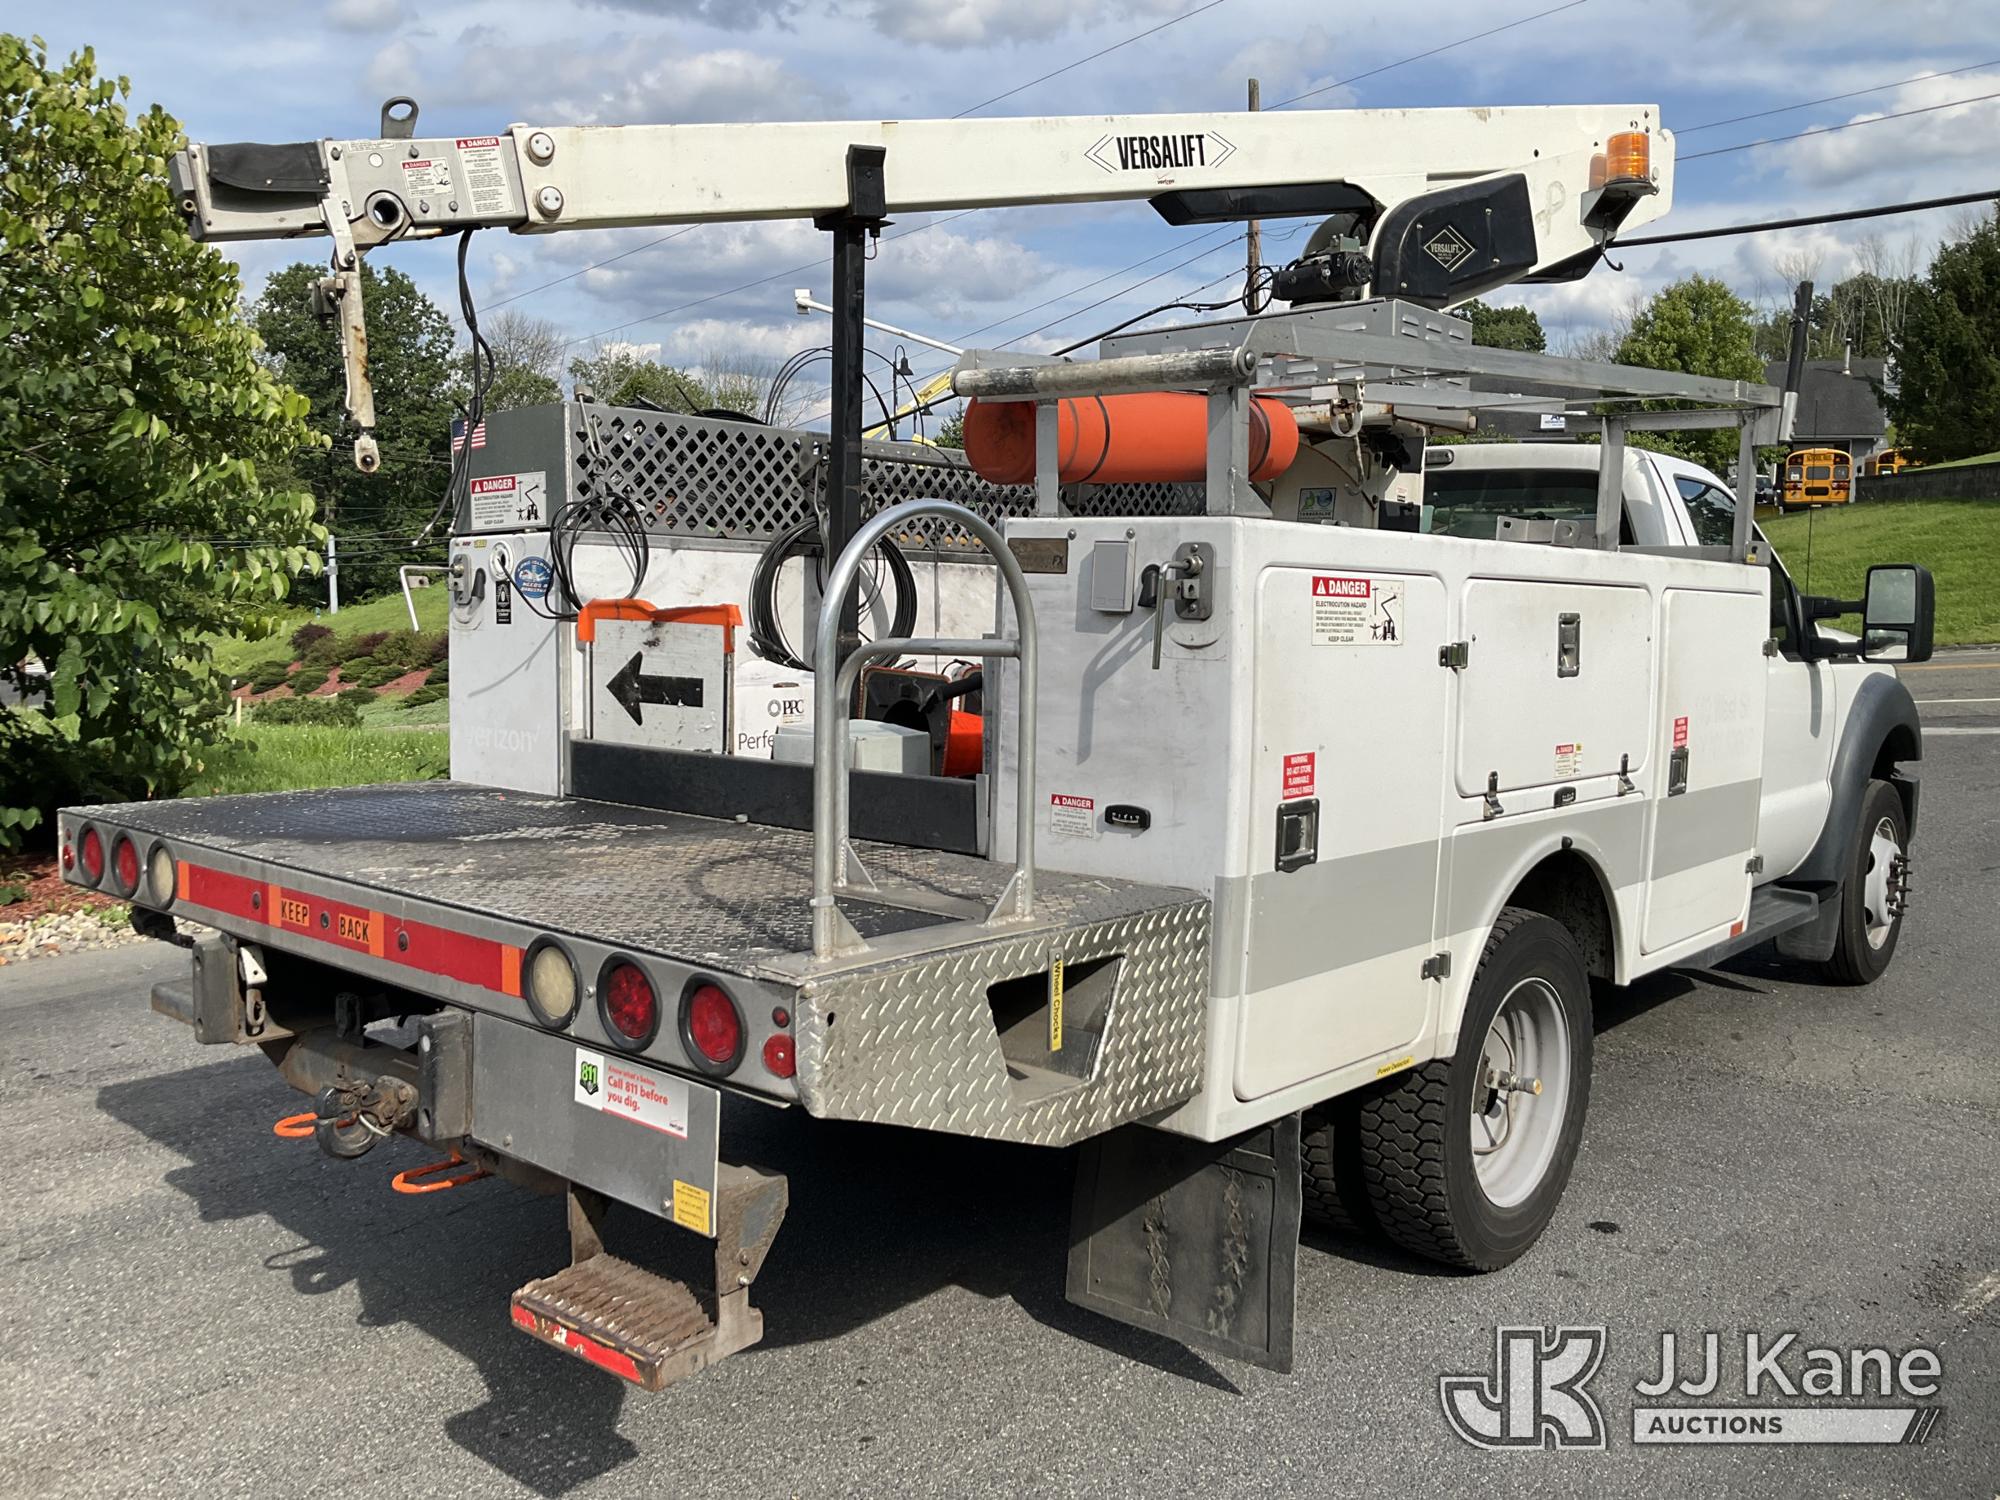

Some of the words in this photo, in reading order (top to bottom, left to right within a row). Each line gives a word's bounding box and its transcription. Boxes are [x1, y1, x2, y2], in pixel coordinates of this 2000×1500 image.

[467, 139, 497, 147] DANGER
[1116, 134, 1205, 170] VERSALIFT
[483, 478, 513, 491] DANGER
[1328, 580, 1367, 595] DANGER
[1316, 600, 1350, 608] ELECTROCUTION
[783, 700, 804, 714] PPC
[1062, 797, 1091, 808] DANGER
[281, 900, 308, 924] KEEP
[340, 916, 369, 942] BACK
[1053, 999, 1061, 1040] Chocks
[580, 1060, 599, 1084] 811
[608, 1075, 623, 1089] Call
[625, 1080, 638, 1094] 811
[640, 1084, 668, 1105] before
[607, 1091, 623, 1103] you
[624, 1096, 640, 1111] dig.
